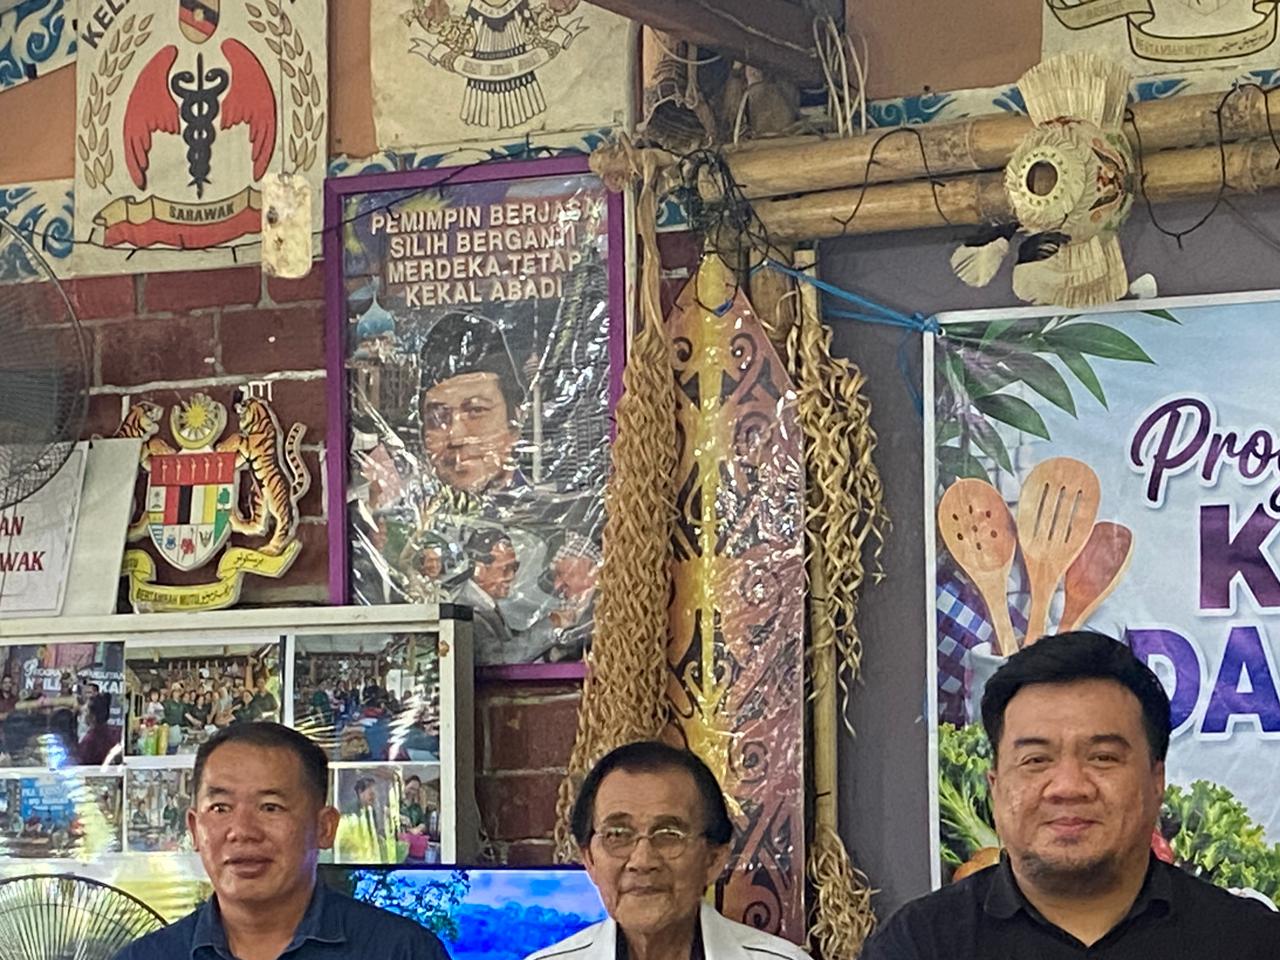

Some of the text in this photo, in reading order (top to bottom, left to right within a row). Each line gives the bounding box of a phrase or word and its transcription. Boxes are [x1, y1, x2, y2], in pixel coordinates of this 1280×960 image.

[169, 201, 235, 222] SARAWAK
[371, 206, 481, 235] PEMIMPIN
[390, 224, 577, 259] SILIH BERGANTI
[388, 251, 582, 284] MERDEKA TETAP
[405, 277, 563, 307] KEKAL ABADI
